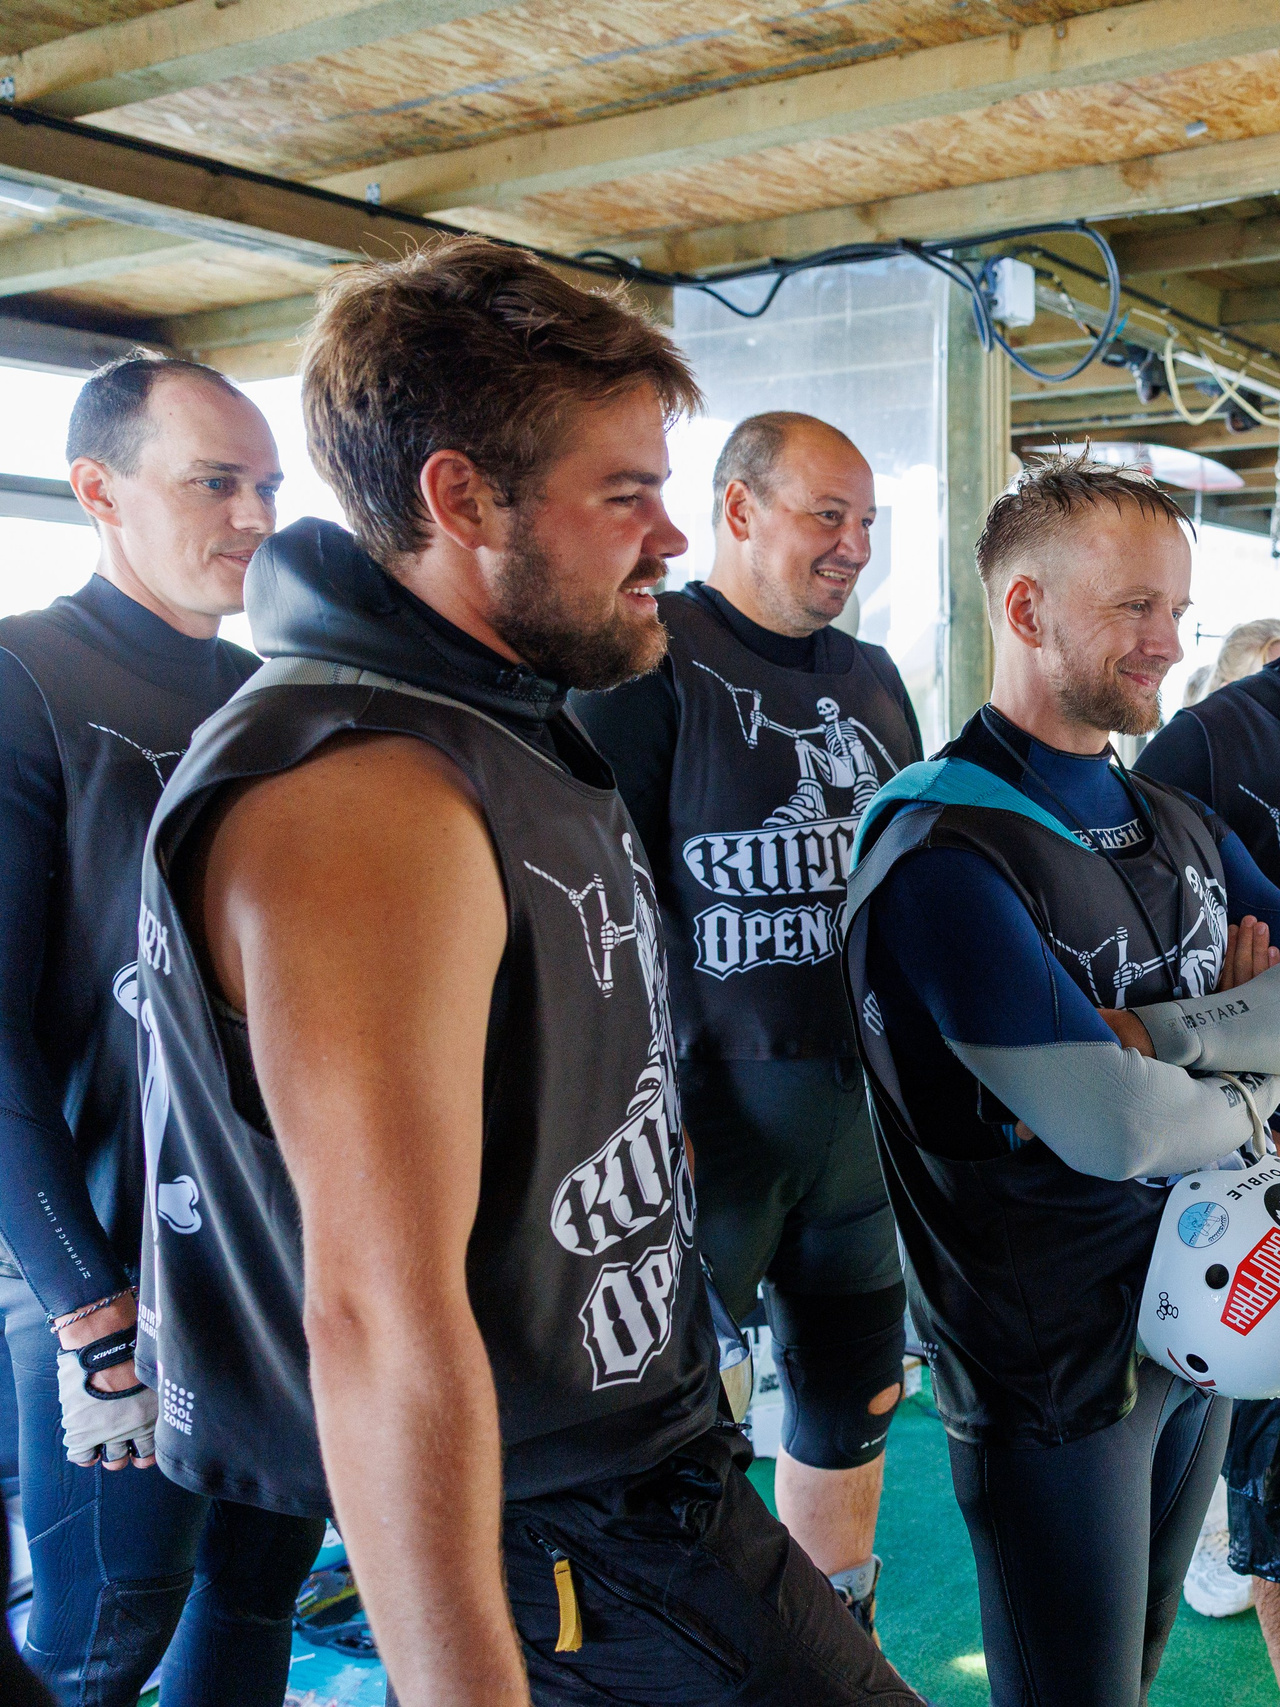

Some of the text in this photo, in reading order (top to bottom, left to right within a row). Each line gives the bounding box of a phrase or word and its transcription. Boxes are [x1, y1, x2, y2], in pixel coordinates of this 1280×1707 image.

[702, 905, 830, 974] OPEN
[37, 1190, 86, 1274] FURNACE LINED
[91, 1343, 127, 1362] DEMIX
[162, 1408, 193, 1437] ZONE
[163, 1397, 194, 1424] COOL
